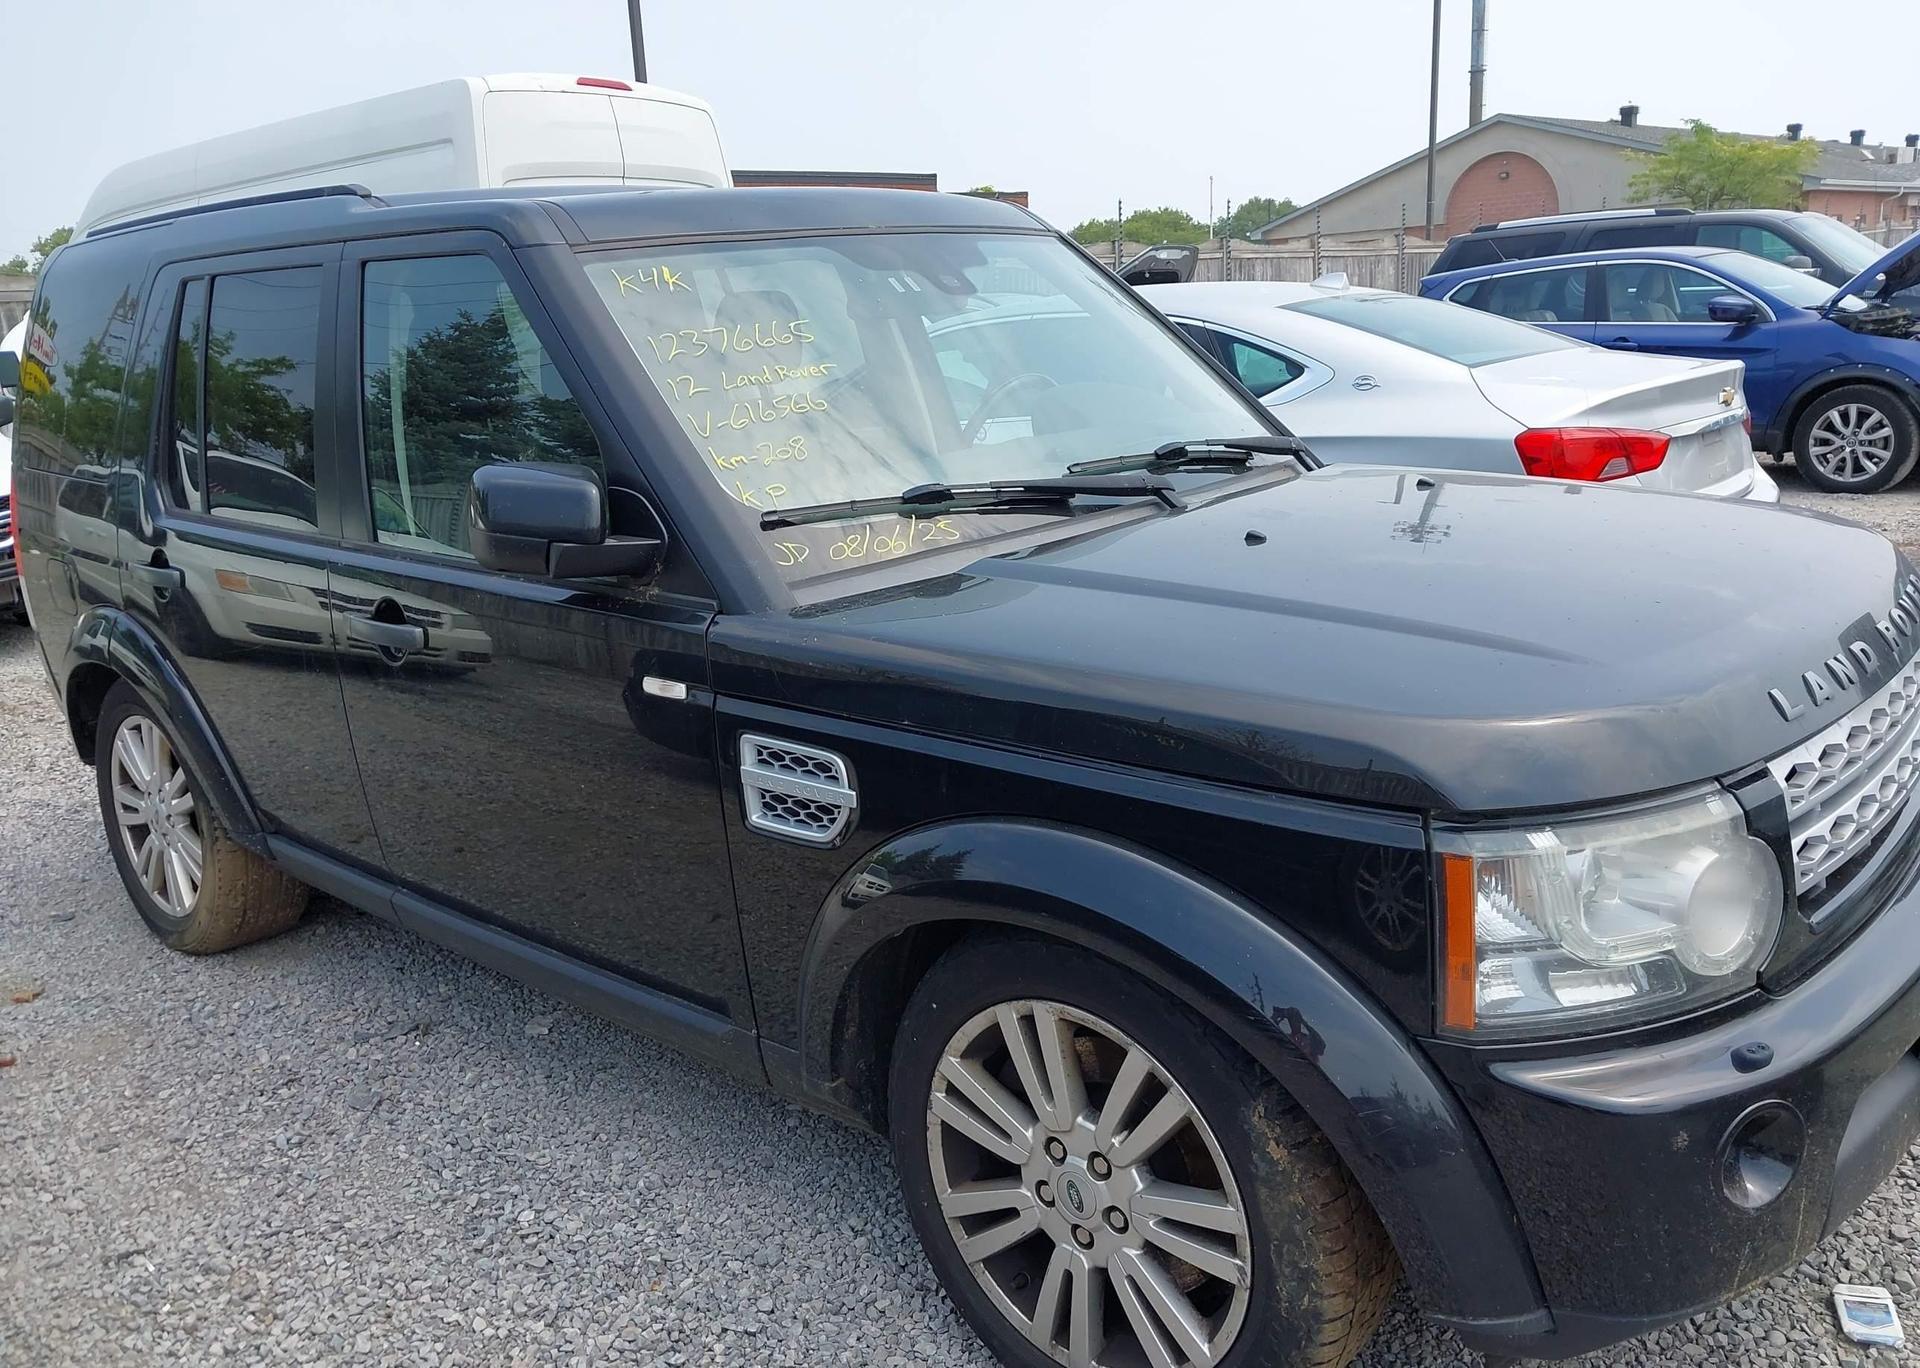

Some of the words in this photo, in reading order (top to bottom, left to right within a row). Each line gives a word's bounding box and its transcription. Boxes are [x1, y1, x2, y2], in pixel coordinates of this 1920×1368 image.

[647, 319, 815, 365] 12376665
[666, 375, 713, 401] 12
[721, 365, 773, 391] Land
[774, 363, 838, 382] Rover
[1767, 639, 1878, 723] LAND
